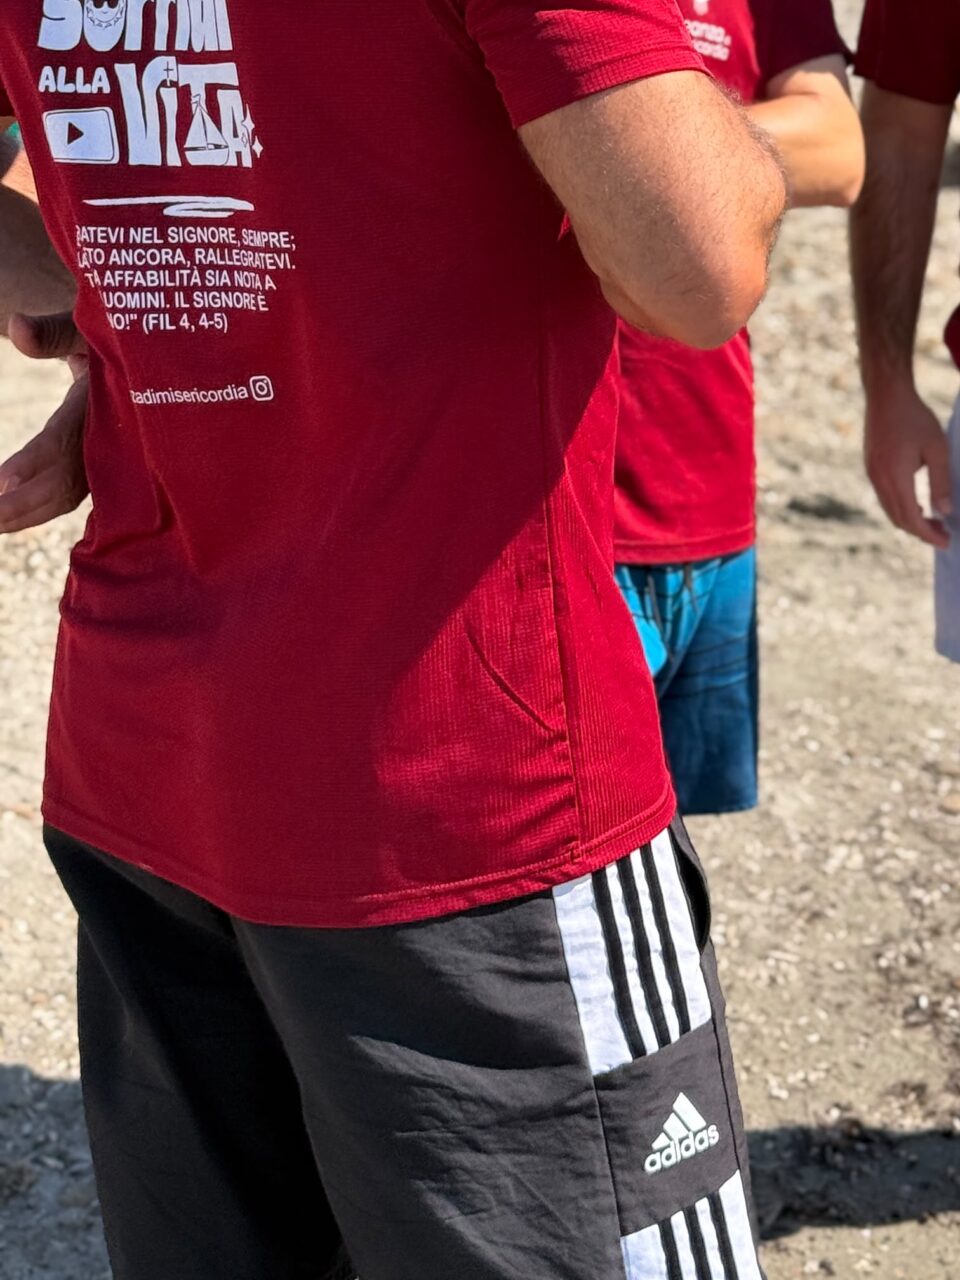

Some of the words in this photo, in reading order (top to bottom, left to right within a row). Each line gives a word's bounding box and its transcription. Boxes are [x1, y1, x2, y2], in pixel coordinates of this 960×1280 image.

[38, 66, 110, 93] ALLA
[129, 226, 164, 244] NEL
[167, 226, 240, 247] SIGNORE,
[241, 228, 296, 251] SEMPRE;
[109, 248, 191, 267] ANCORA,
[194, 248, 296, 270] RALLEGRATEVI.
[103, 266, 201, 288] AFFABILITÀ
[205, 269, 231, 287] SIA
[234, 270, 263, 291] NOTA
[265, 274, 277, 291] A
[175, 291, 190, 309] IL
[193, 291, 256, 311] SIGNORE
[257, 291, 269, 311] È
[142, 313, 177, 335] (FIL
[179, 313, 195, 333] 4,
[198, 313, 228, 334] 4-5)
[643, 1124, 720, 1175] adidas
